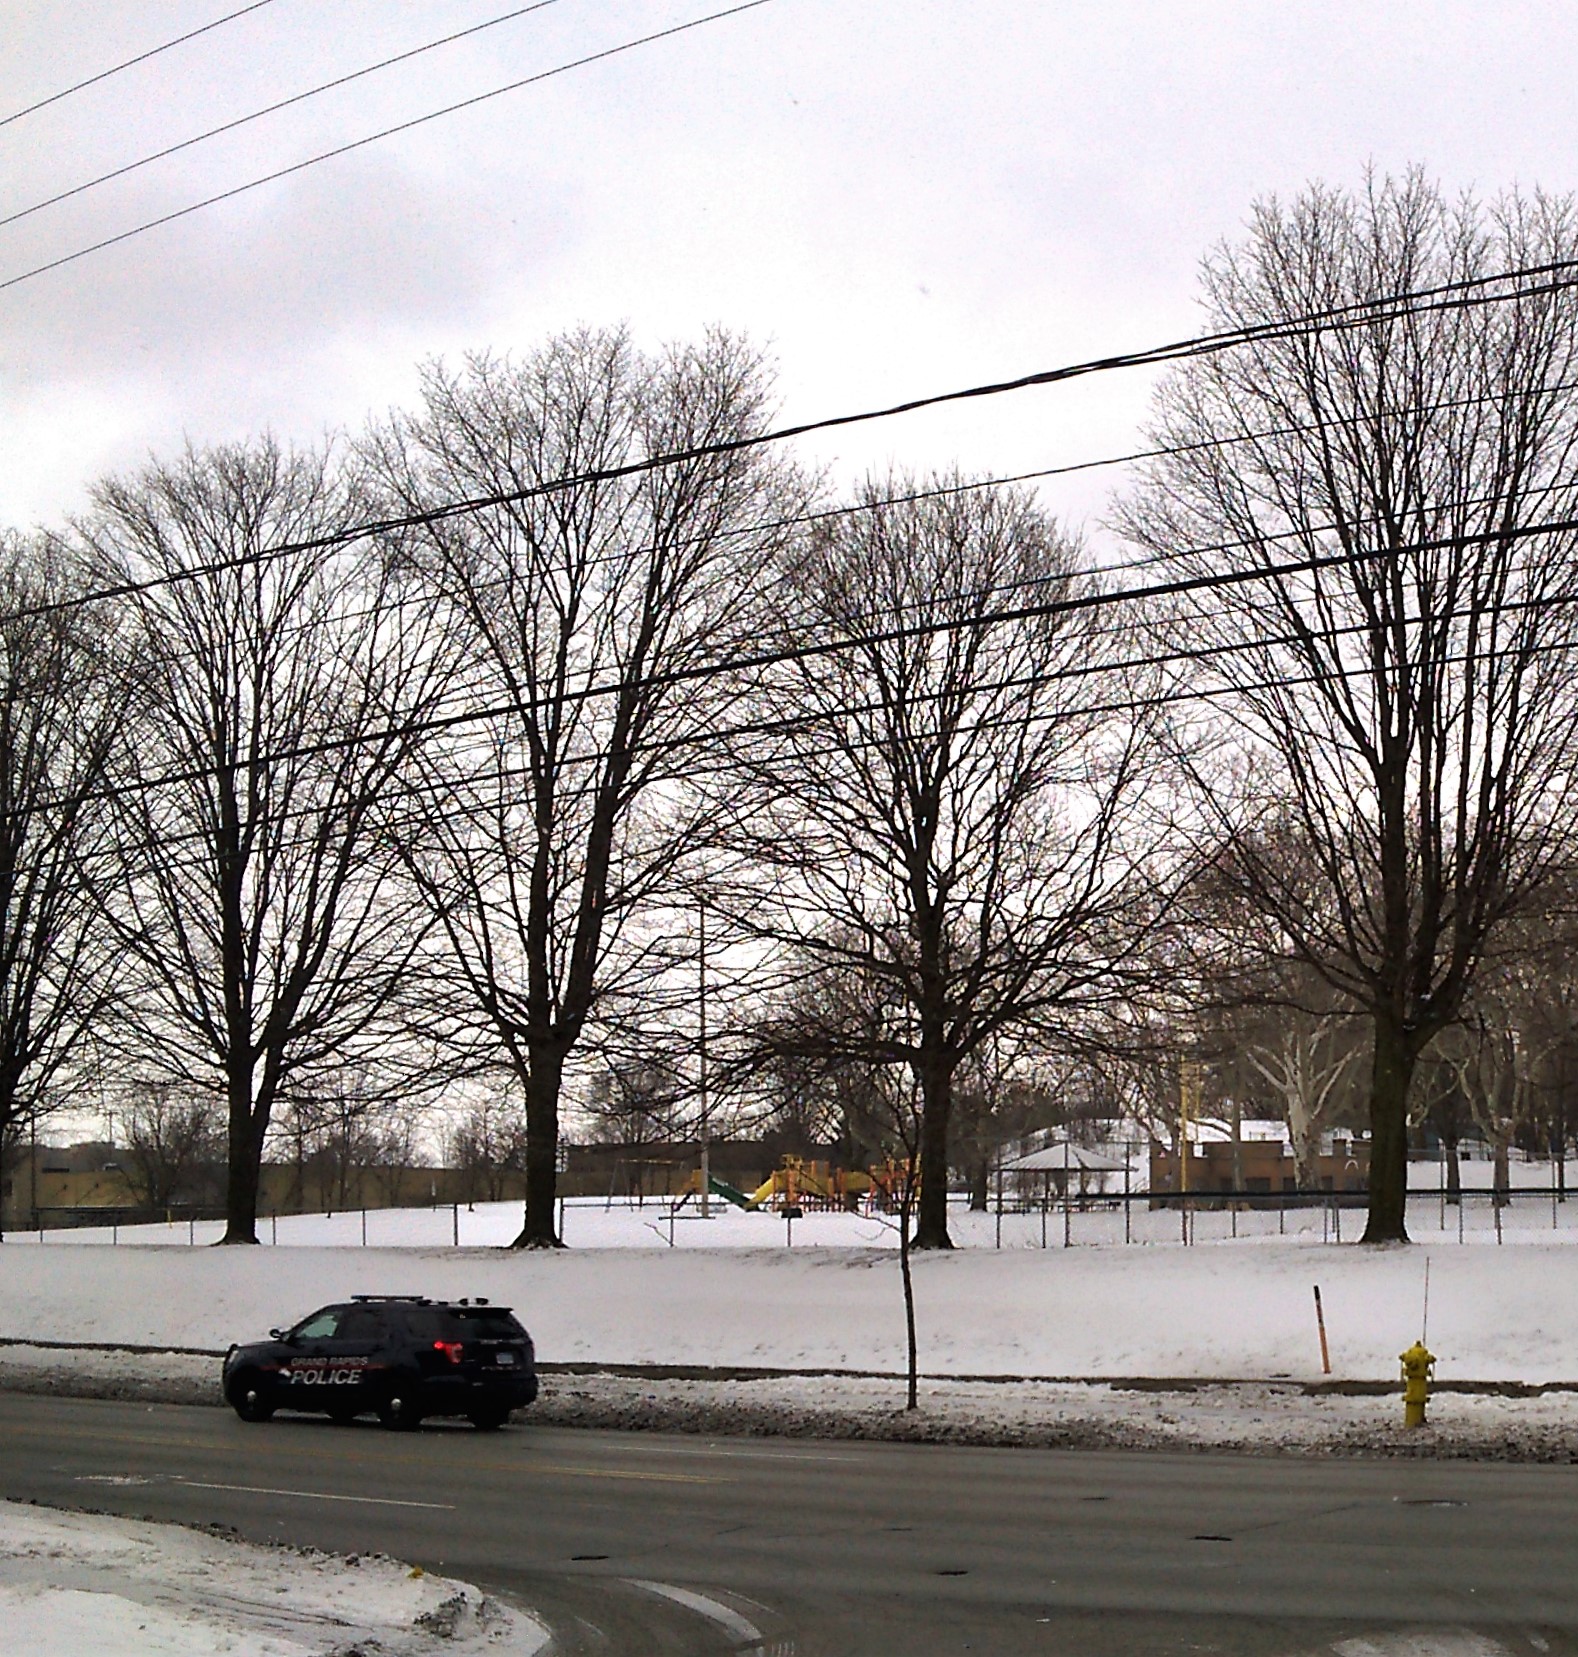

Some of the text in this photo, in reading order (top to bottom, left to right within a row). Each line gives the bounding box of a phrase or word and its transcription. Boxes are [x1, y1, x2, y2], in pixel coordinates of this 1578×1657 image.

[291, 1356, 368, 1367] GRAND RAPIDS
[290, 1369, 363, 1385] POLICE
